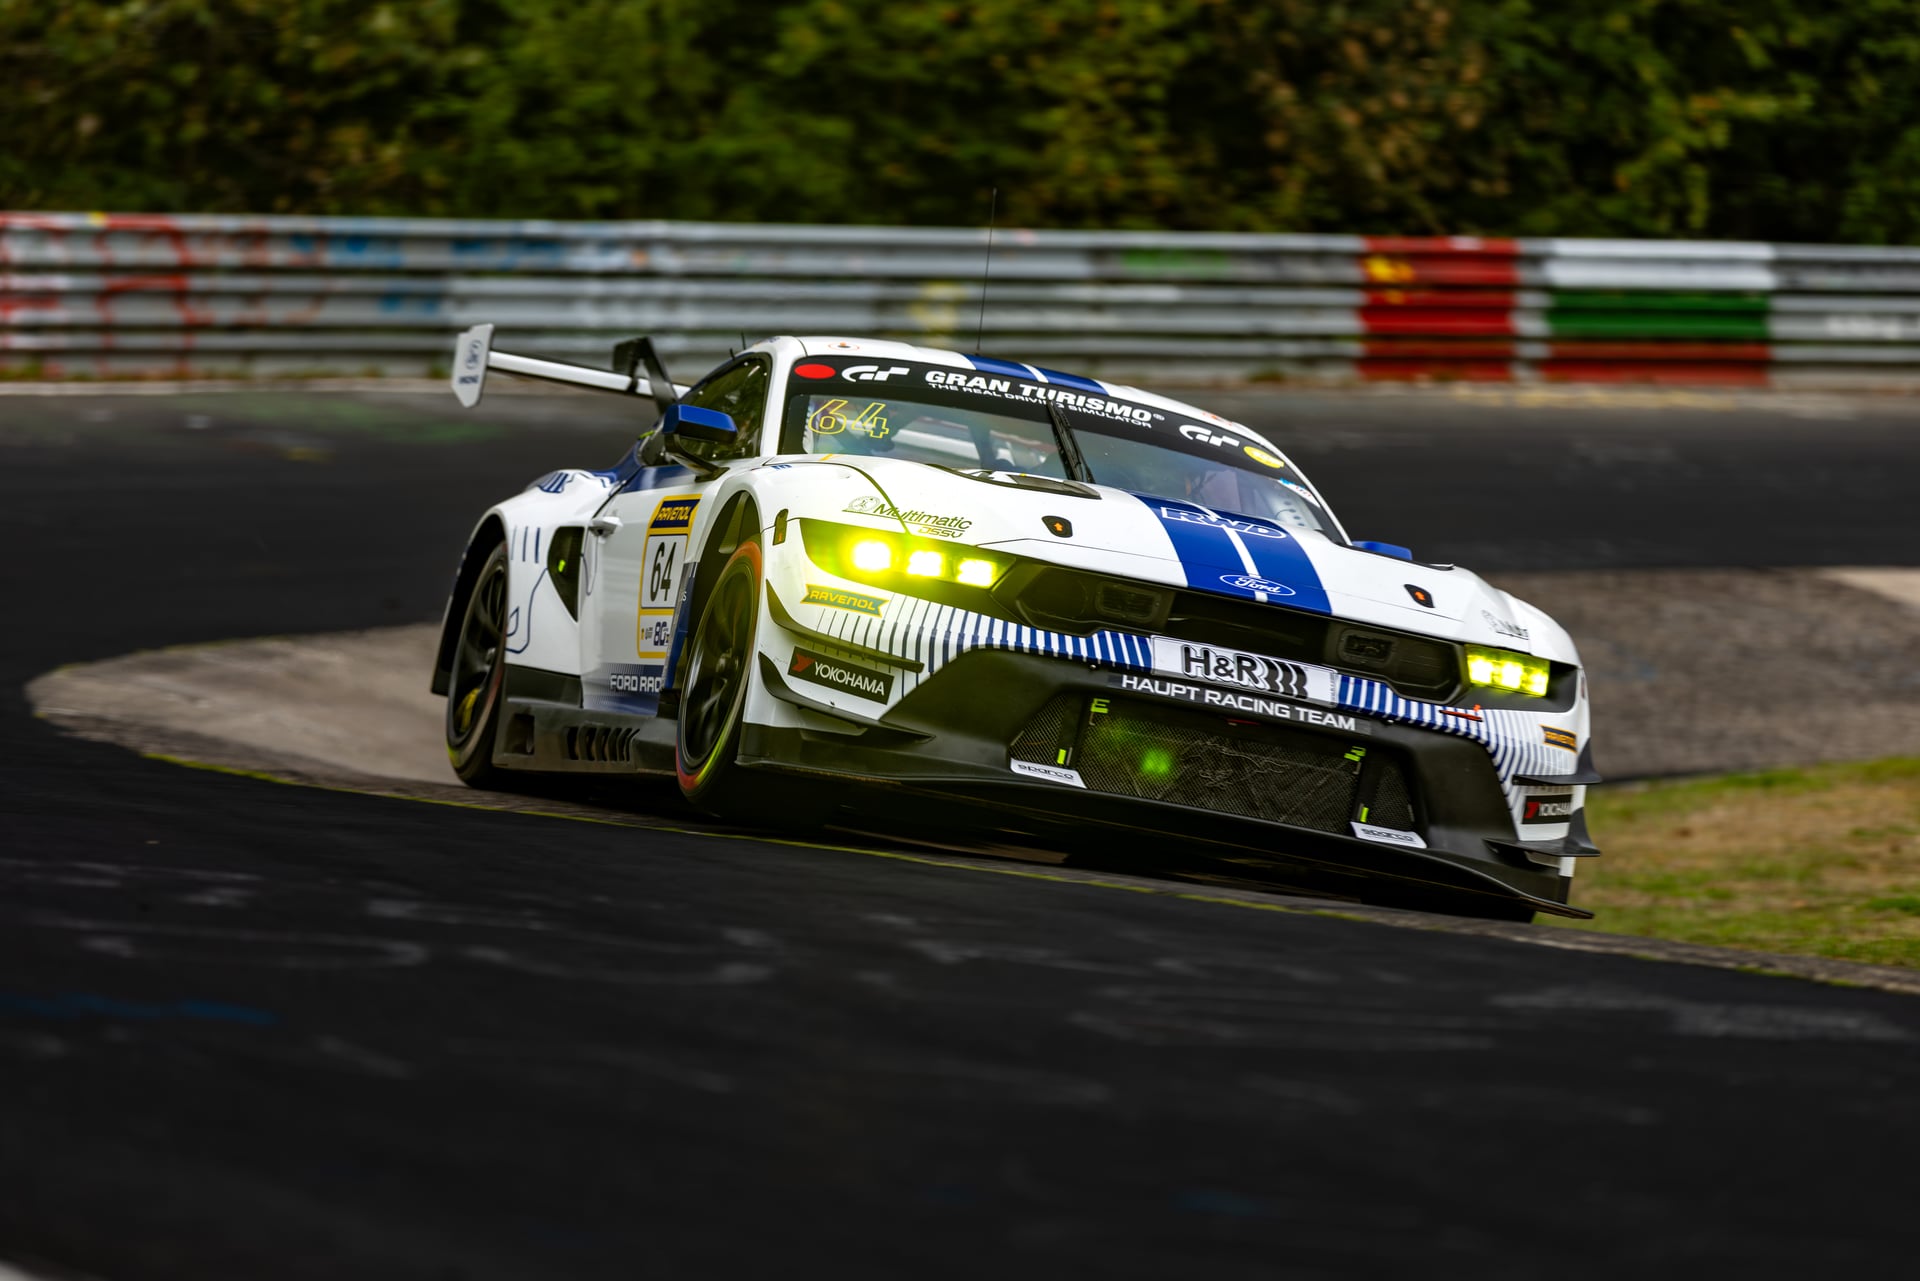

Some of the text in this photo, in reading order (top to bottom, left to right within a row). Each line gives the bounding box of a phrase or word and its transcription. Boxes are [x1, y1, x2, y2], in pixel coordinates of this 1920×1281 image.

[925, 370, 1011, 393] GRAN
[807, 398, 890, 440] 64
[928, 382, 959, 392] THE
[962, 386, 1002, 398] REAL
[1068, 405, 1152, 429] SIMULATOR
[873, 503, 973, 530] Multimatic
[650, 541, 677, 602] 64
[1235, 577, 1281, 593] Ford
[809, 590, 876, 611] RAVENOL
[609, 674, 639, 692] FORD
[814, 662, 885, 696] YOKOHAMA
[1181, 645, 1266, 690] H&R
[1121, 675, 1356, 731] HAUPT RACING TEAM
